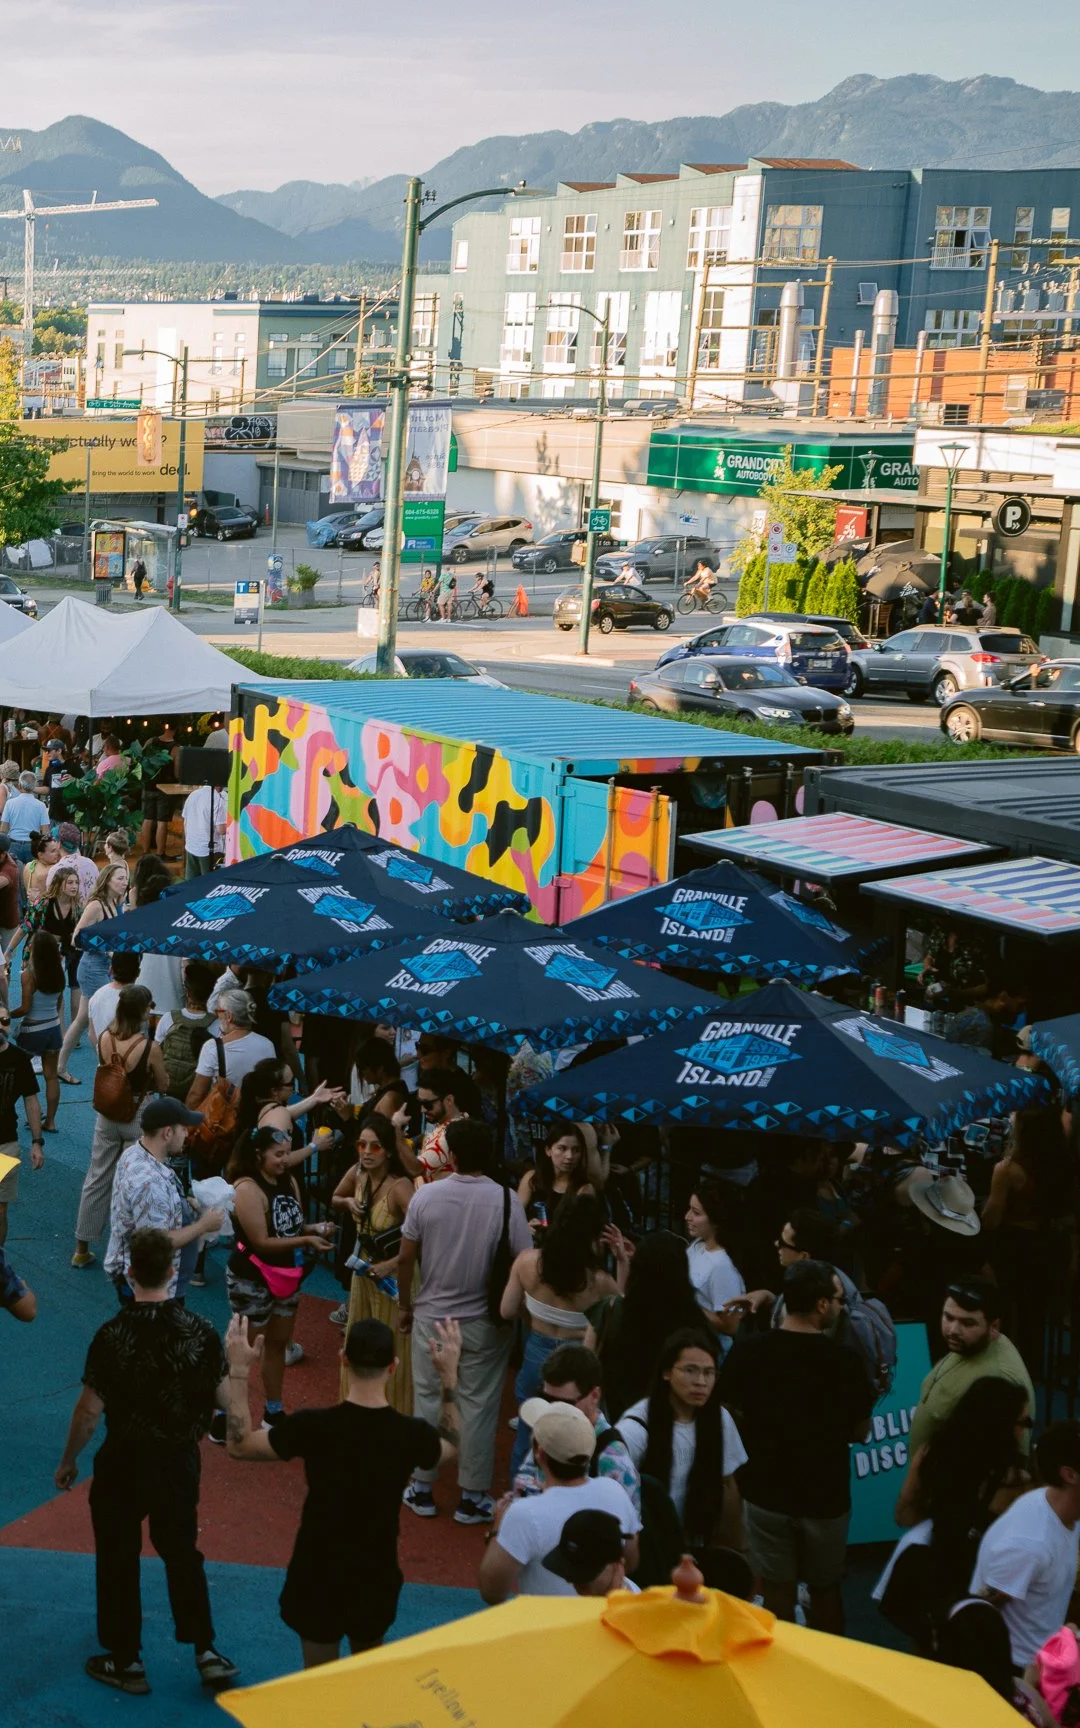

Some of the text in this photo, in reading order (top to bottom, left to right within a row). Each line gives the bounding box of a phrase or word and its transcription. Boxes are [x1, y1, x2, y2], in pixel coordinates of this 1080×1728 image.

[91, 470, 107, 478] Bring
[736, 470, 772, 482] AUTOBODY
[285, 848, 345, 867] GRANVILLE
[205, 884, 270, 904] GRANVILLE
[672, 887, 749, 914] GRANVILLE
[171, 911, 225, 930] ISLAND
[659, 916, 726, 942] ISLAND
[422, 938, 496, 965] GRANVILLE
[385, 969, 450, 997] ISLAND
[700, 1021, 802, 1046] GRANVILLE
[676, 1061, 763, 1088] ISLAND
[856, 1441, 907, 1478] DISC
[104, 1660, 116, 1672] N
